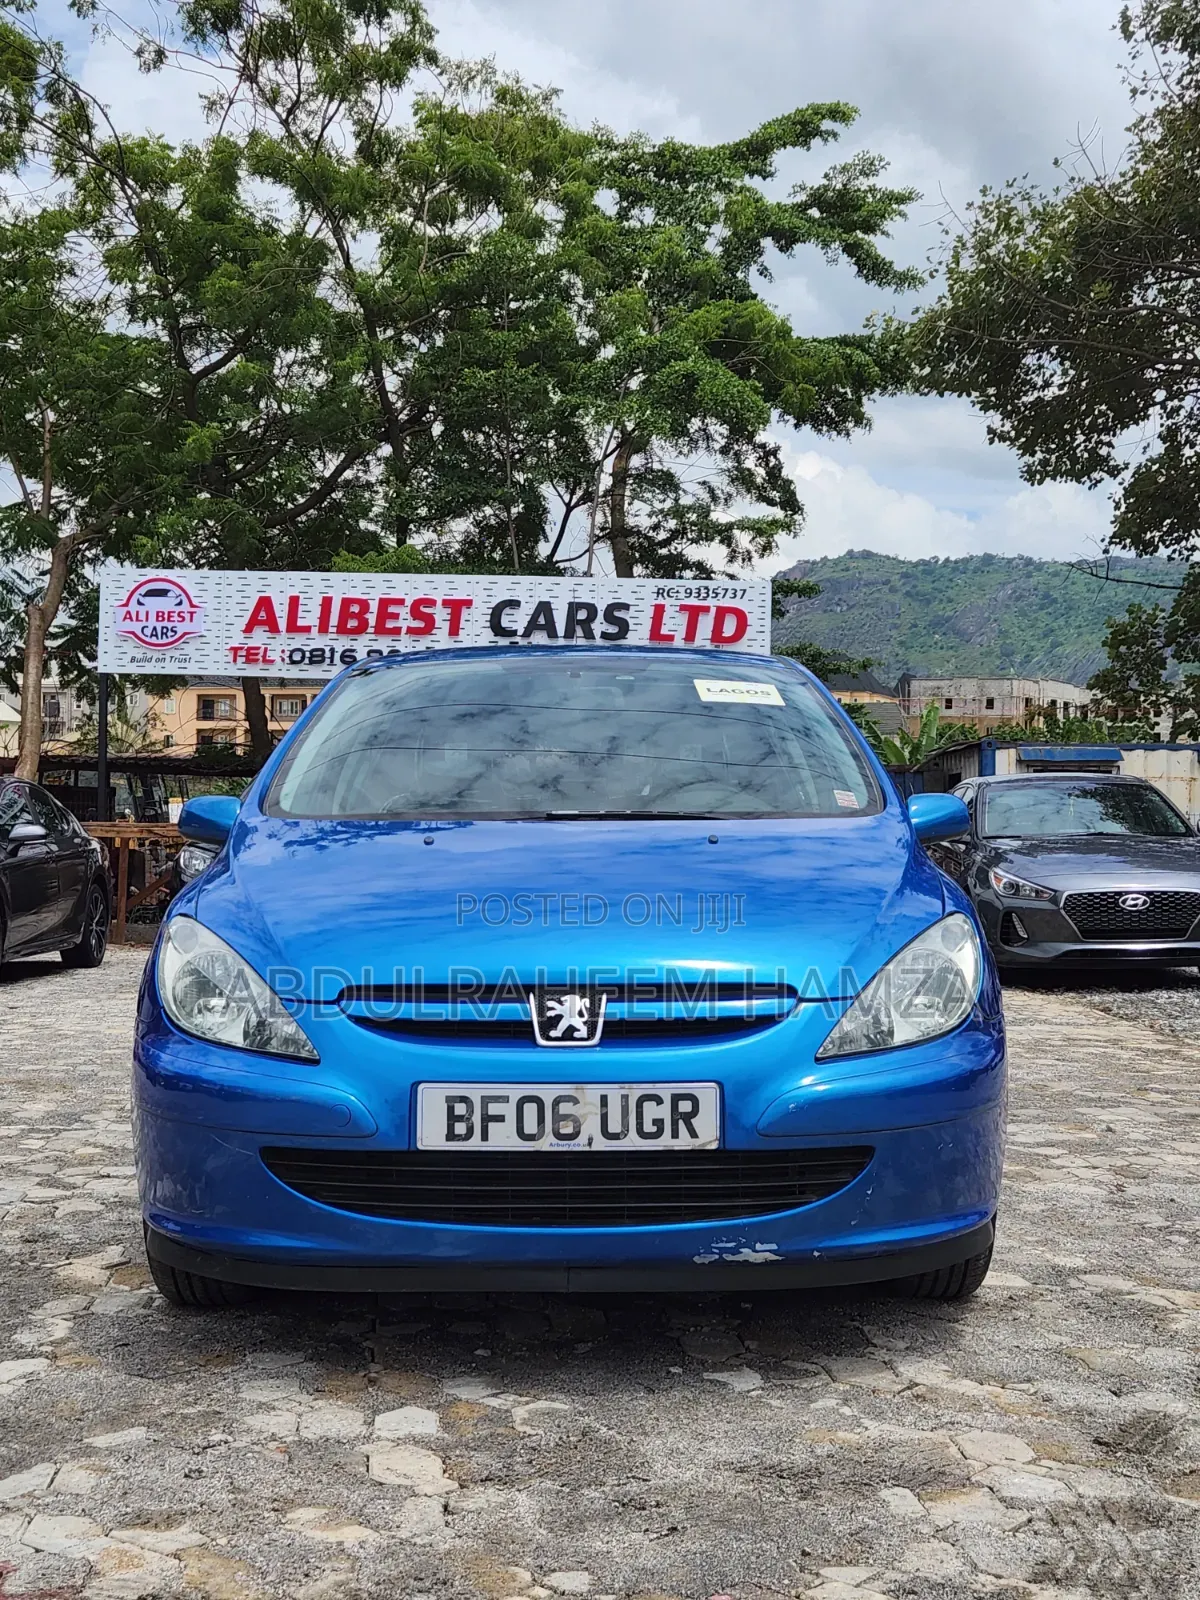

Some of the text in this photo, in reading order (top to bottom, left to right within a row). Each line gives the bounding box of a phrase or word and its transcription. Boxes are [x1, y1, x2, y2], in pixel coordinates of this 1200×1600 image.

[684, 587, 748, 600] 9335737
[122, 610, 197, 623] ALI BEST
[242, 595, 748, 645] ALIBEST CARS LTD
[141, 625, 178, 640] CARS
[130, 655, 192, 664] Build on Trust
[706, 687, 772, 696] LAGOS
[444, 1093, 700, 1142] BF06 UGR
